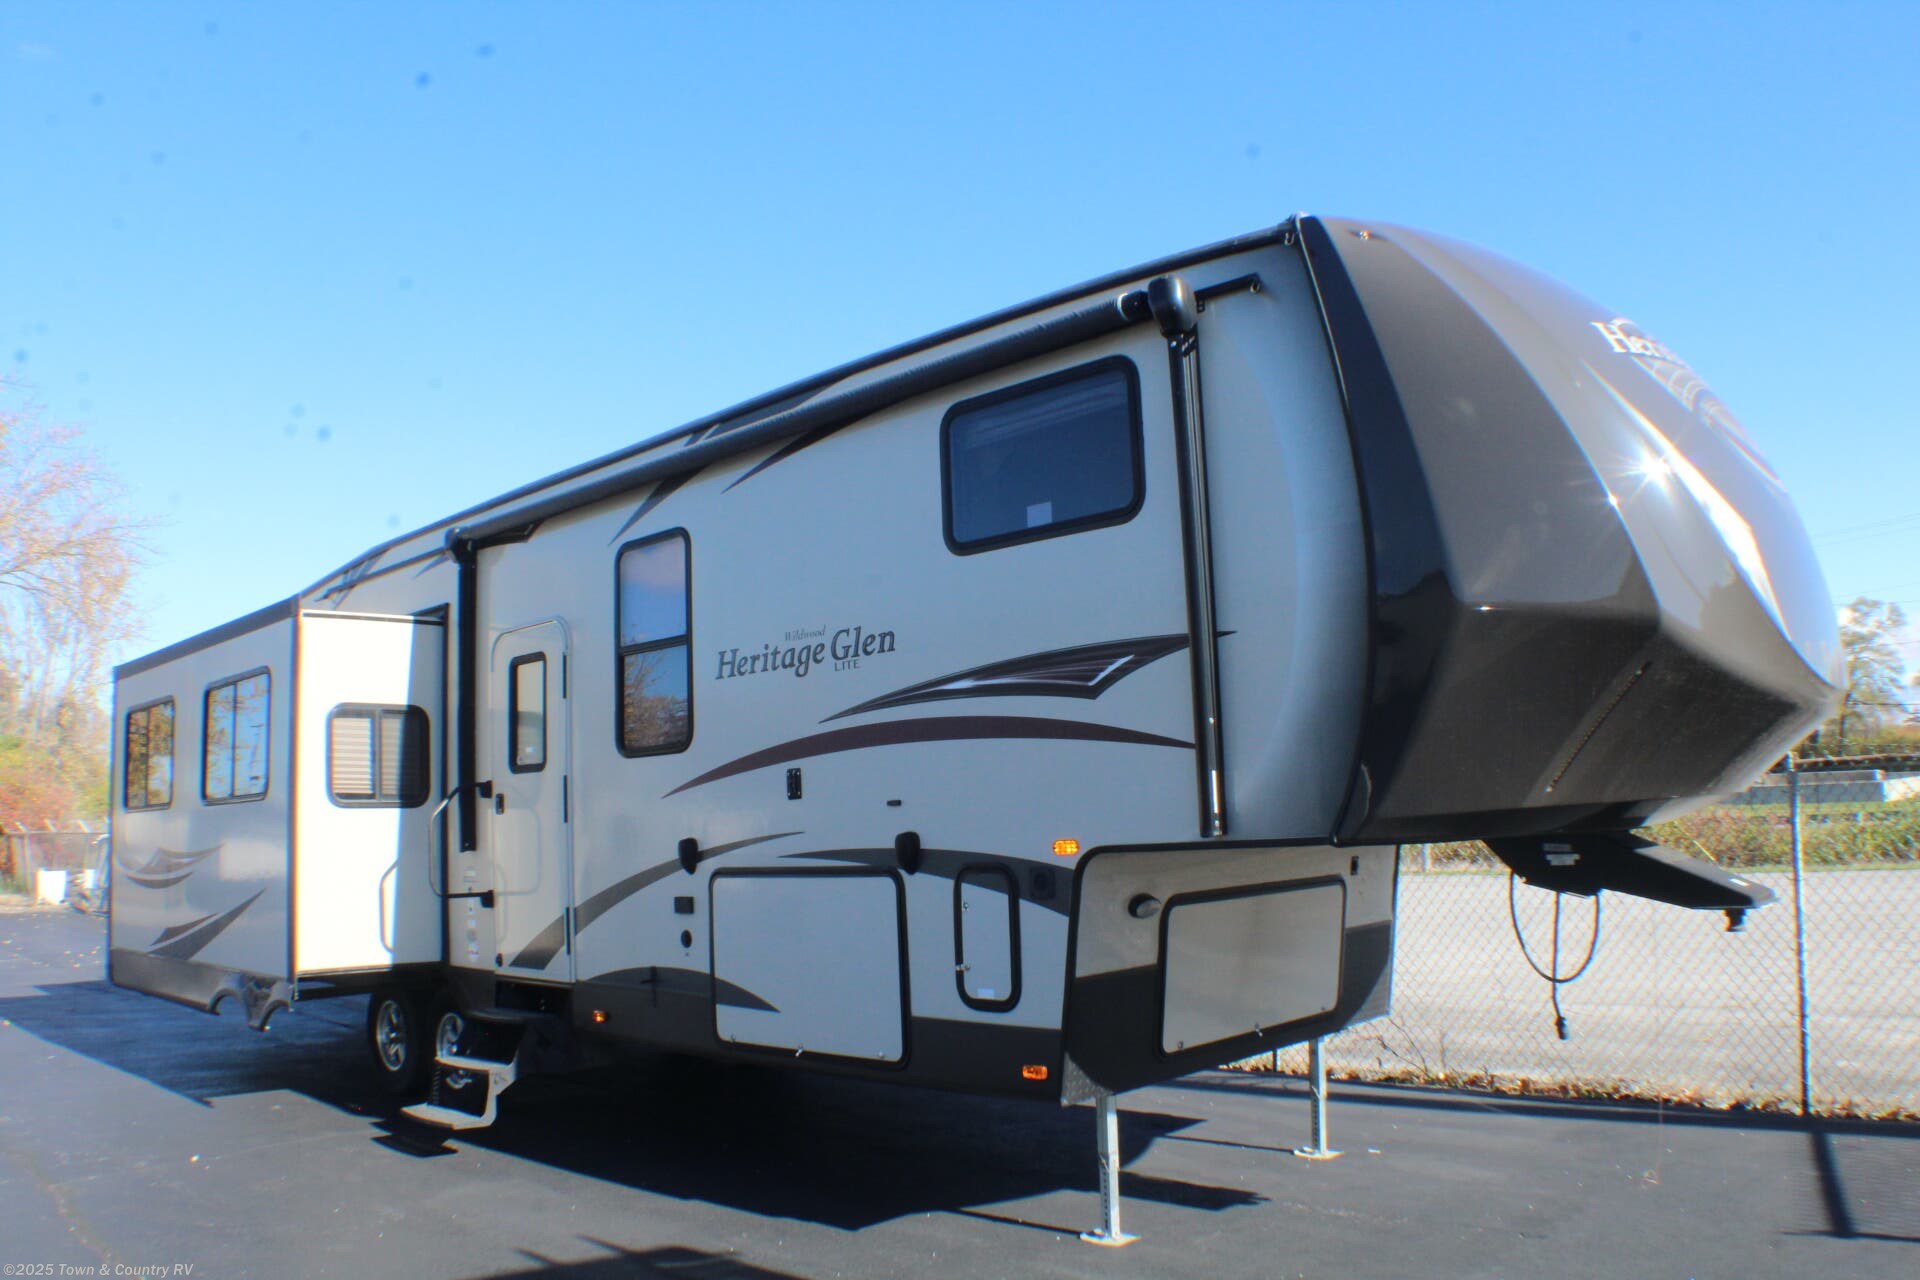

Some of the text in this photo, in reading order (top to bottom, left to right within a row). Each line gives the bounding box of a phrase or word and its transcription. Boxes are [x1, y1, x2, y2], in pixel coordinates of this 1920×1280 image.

[785, 625, 826, 641] Wildwood
[715, 625, 896, 680] Heritage Glen
[834, 659, 861, 672] LITE
